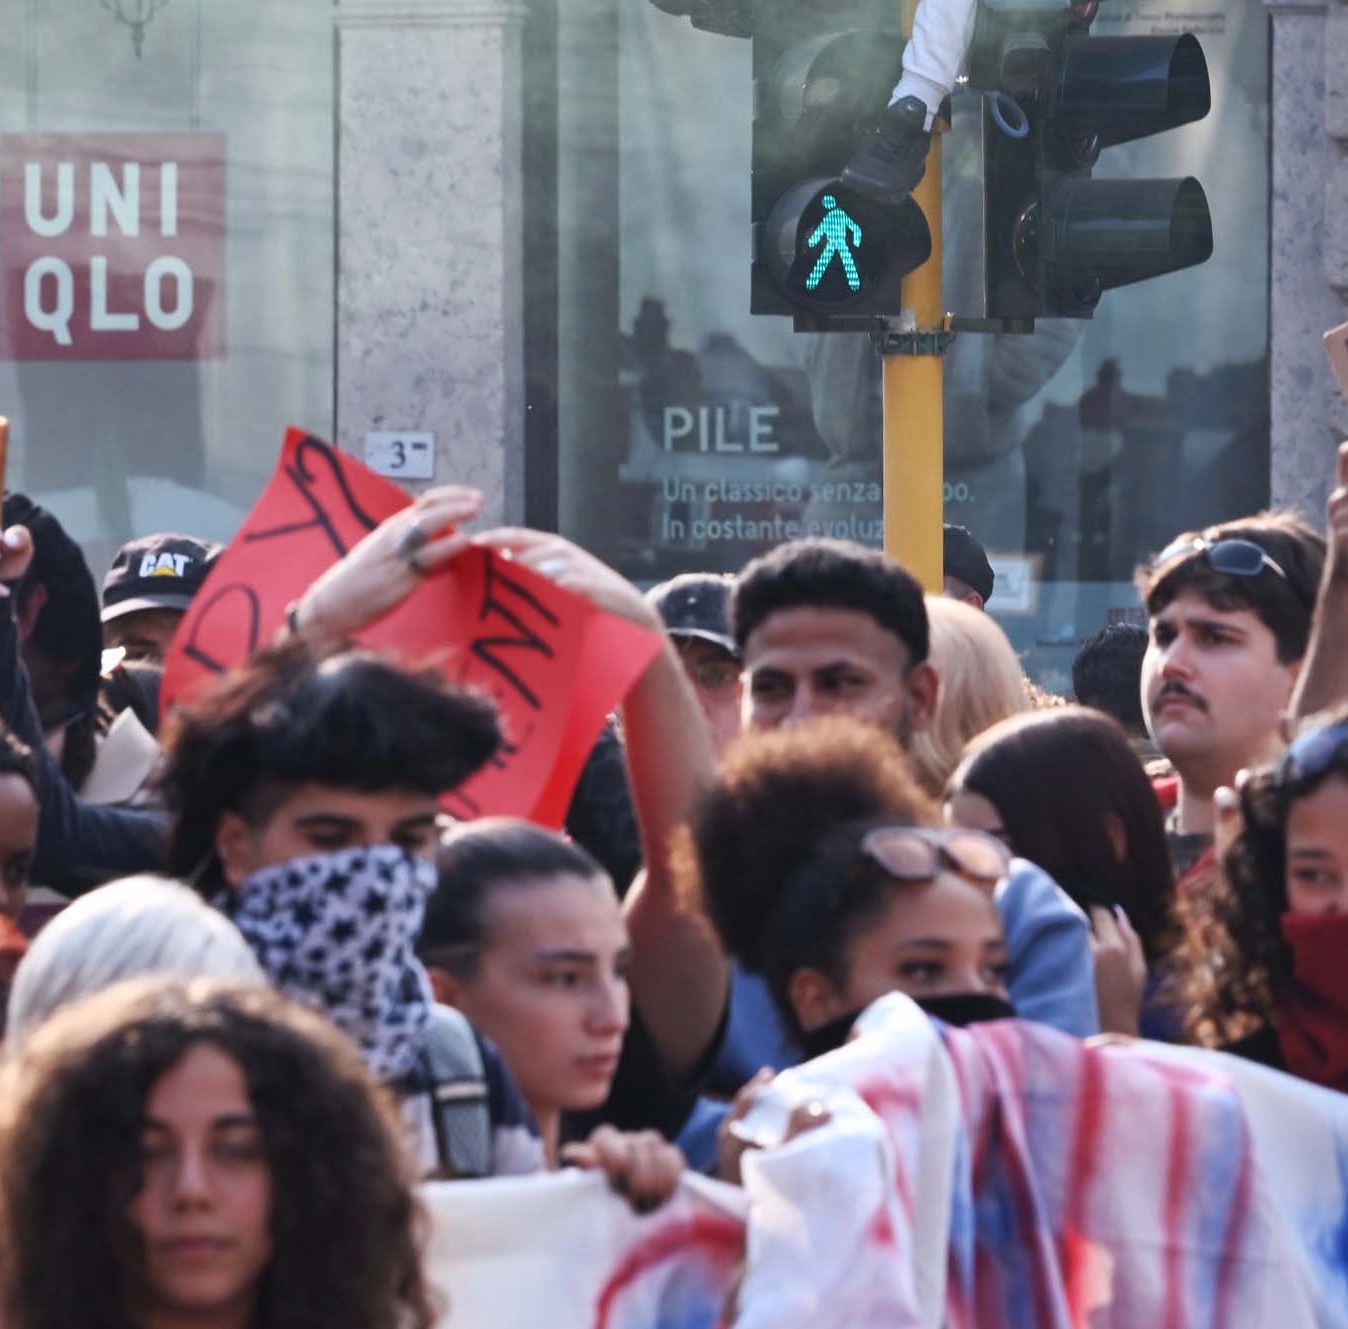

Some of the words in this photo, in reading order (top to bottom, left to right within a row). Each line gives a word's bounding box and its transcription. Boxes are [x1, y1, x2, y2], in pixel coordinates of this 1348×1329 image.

[24, 162, 178, 237] UNI
[24, 256, 194, 345] QLO
[663, 406, 780, 453] PILE
[662, 478, 696, 503] Un
[704, 477, 801, 503] classico
[812, 482, 880, 503] senza
[662, 515, 686, 540] In
[693, 516, 797, 540] costante
[804, 515, 883, 540] evoluz
[139, 552, 190, 578] CAT
